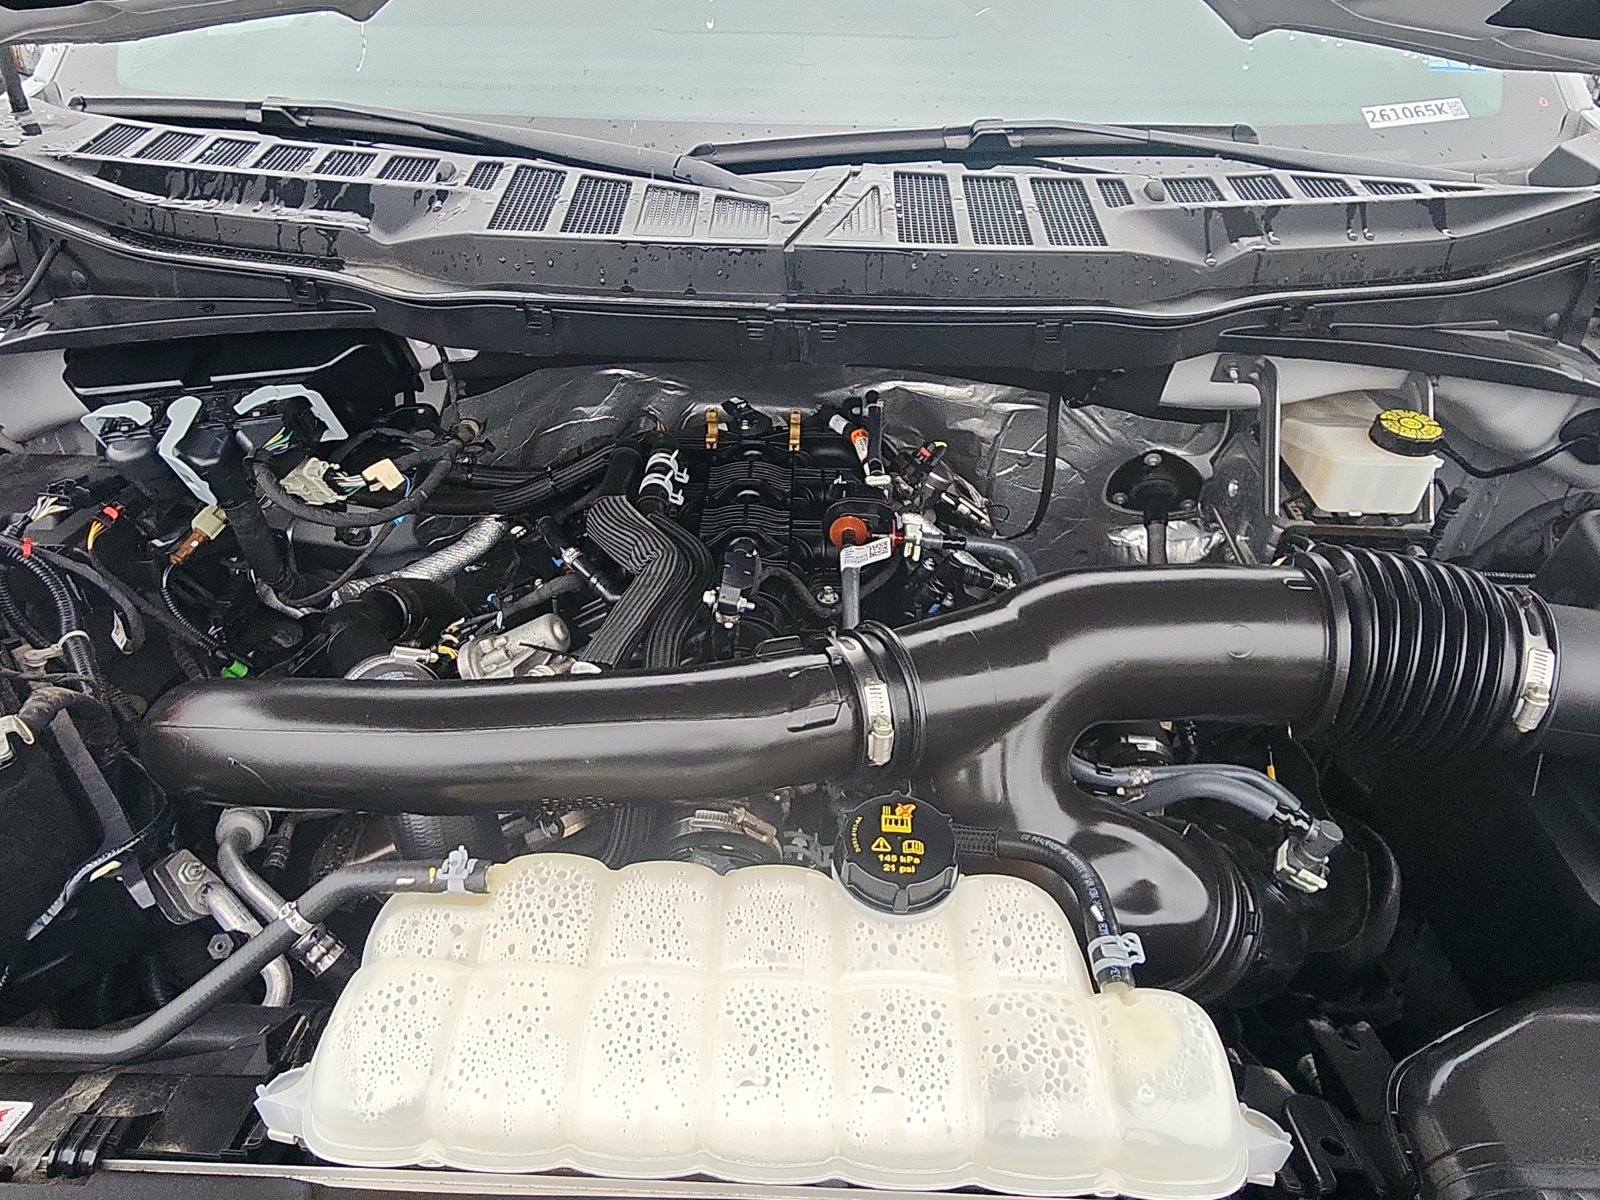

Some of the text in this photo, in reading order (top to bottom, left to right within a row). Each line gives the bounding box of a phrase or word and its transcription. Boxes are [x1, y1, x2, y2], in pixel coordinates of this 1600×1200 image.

[1365, 102, 1450, 123] 261065K
[878, 854, 921, 864] 145 kPa
[882, 863, 916, 874] 21 psi
